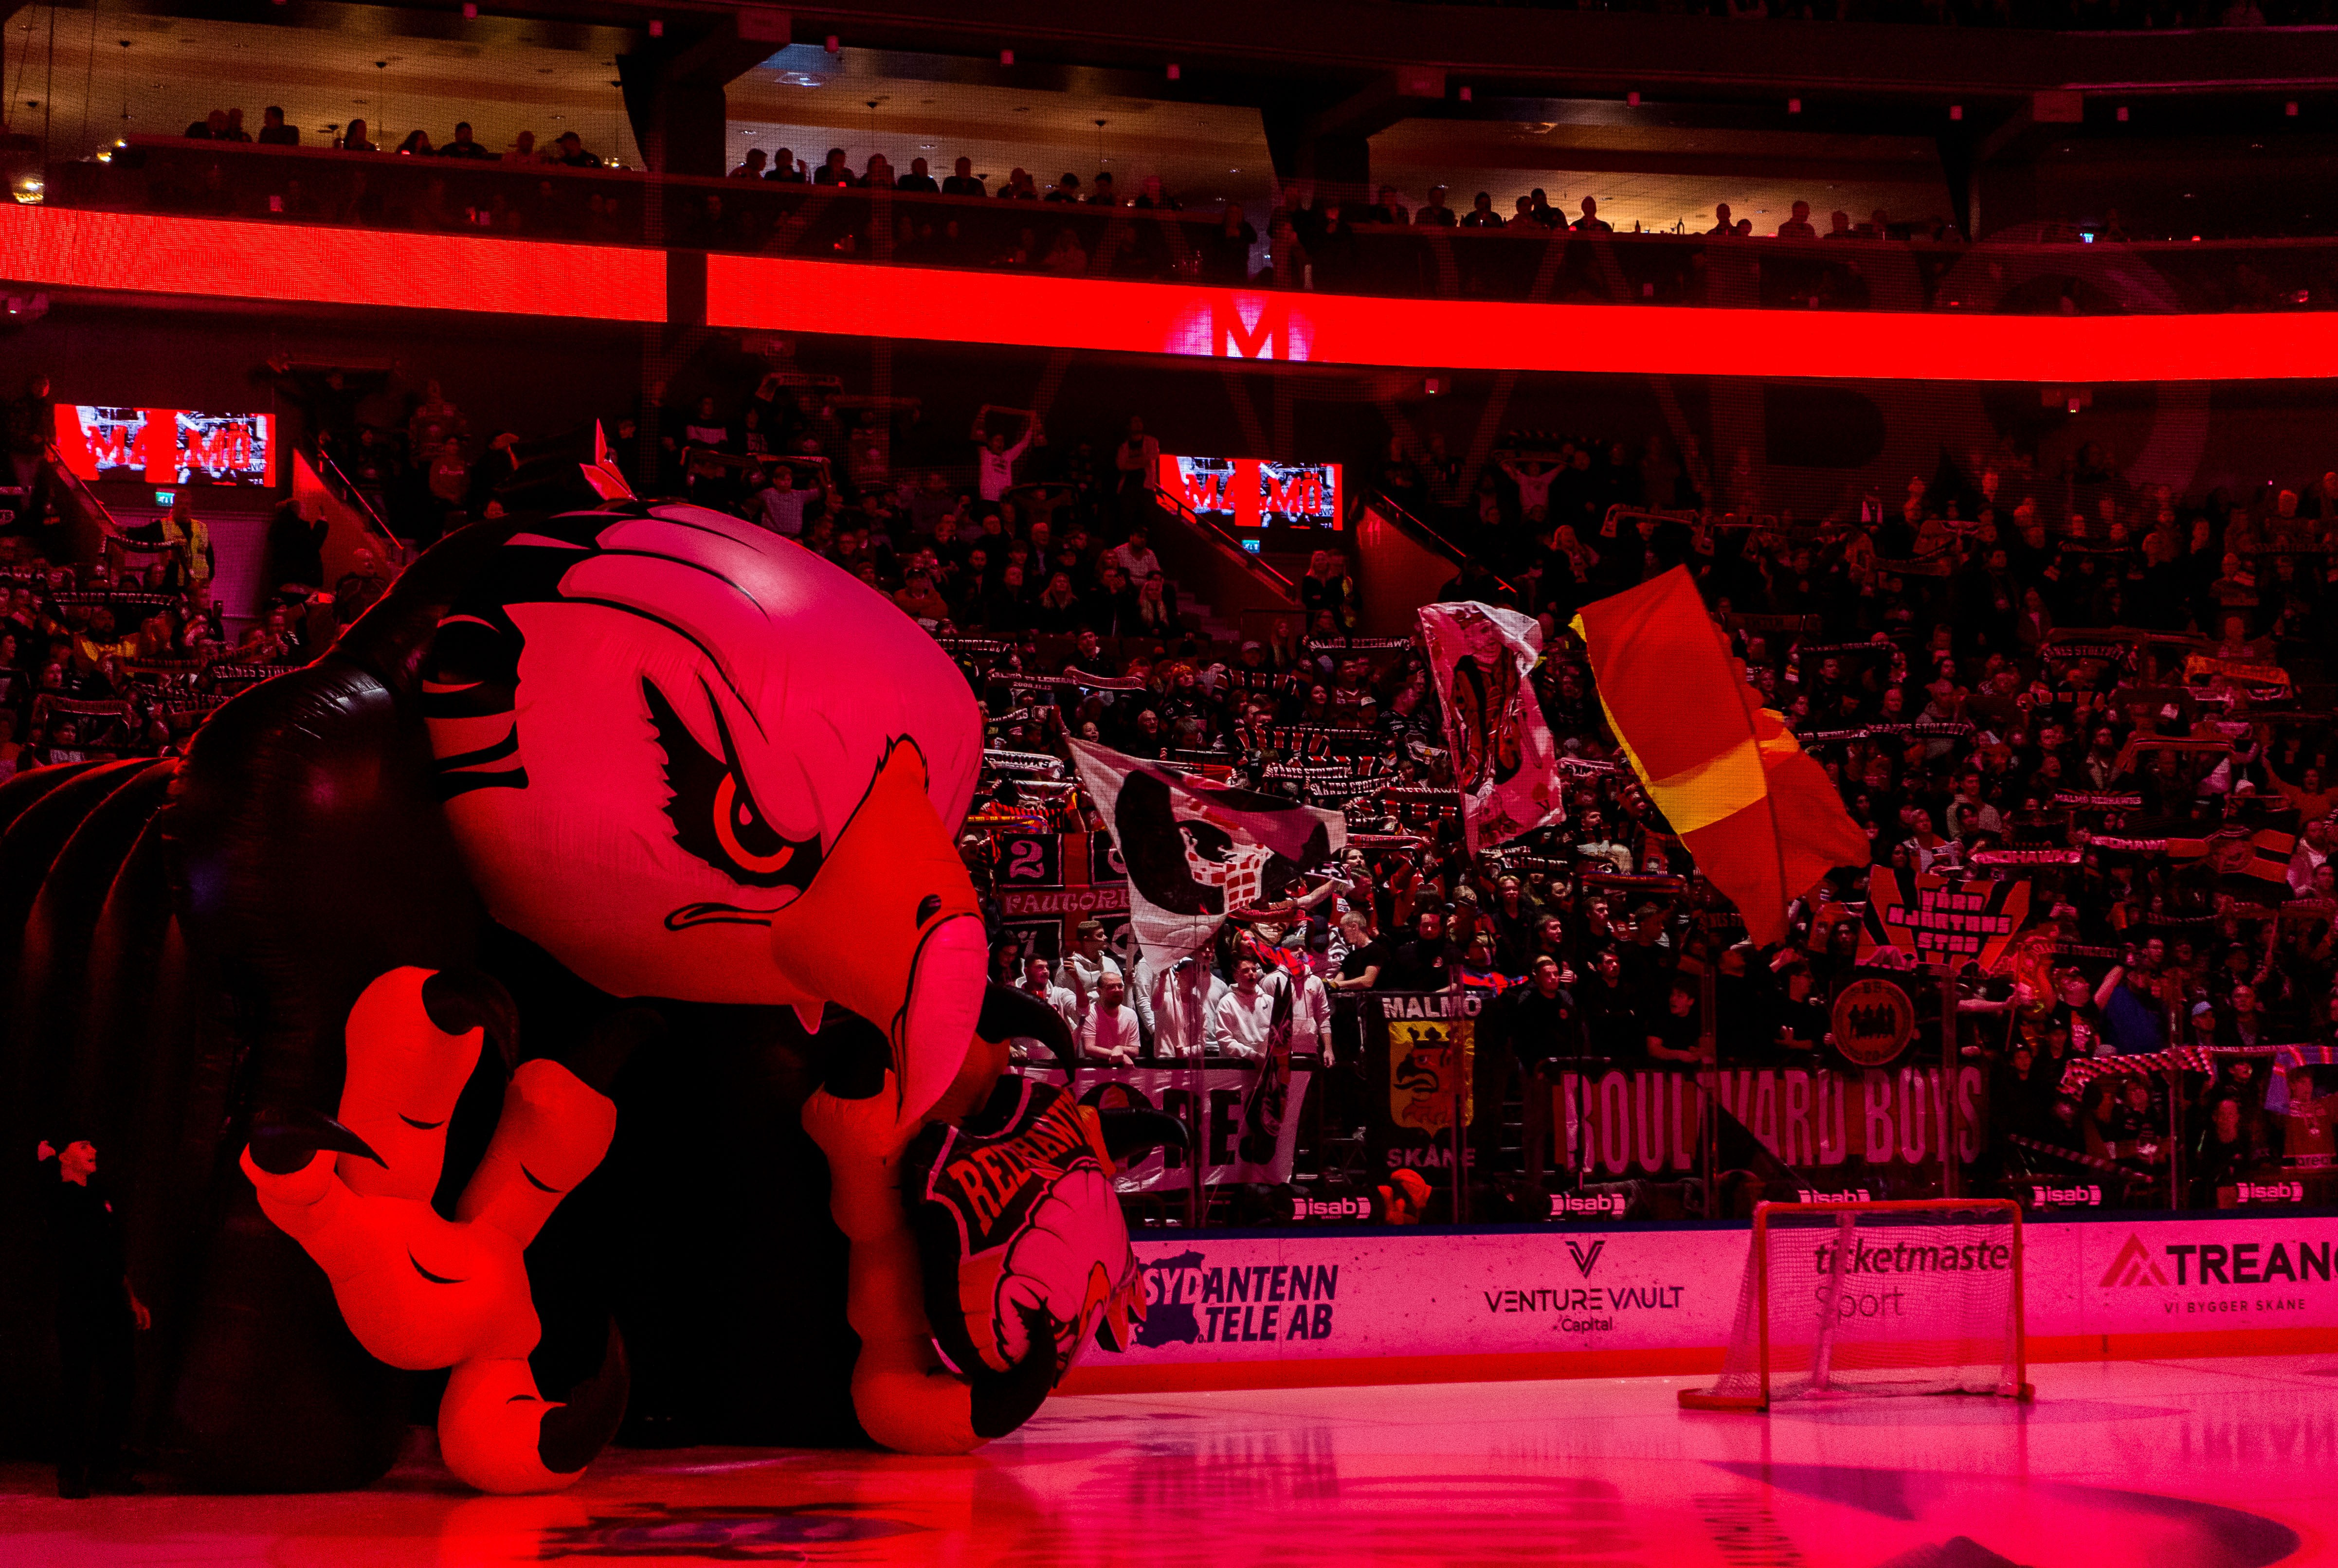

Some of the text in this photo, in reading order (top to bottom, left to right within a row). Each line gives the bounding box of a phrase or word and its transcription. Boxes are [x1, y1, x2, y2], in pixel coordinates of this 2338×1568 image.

[88, 422, 251, 469] MAMÖ
[1185, 472, 1321, 514] MAMÖ
[1010, 840, 1045, 879] 2
[1382, 991, 1483, 1019] MALMÖ
[1865, 1065, 1983, 1165] BOYS
[1387, 1143, 1476, 1168] SKÅNE
[1565, 1193, 1612, 1211] isab
[2046, 1184, 2089, 1202] isab
[2250, 1181, 2290, 1198] isab
[1309, 1197, 1357, 1215] isab
[2166, 1242, 2338, 1286] TREAN
[1142, 1265, 1339, 1306] SYDANTENN
[1484, 1286, 1685, 1313] VENTURE VAULT
[2165, 1296, 2306, 1314] VI BYGGER SKÅNE
[1287, 1303, 1334, 1340] AB
[1561, 1316, 1613, 1334] Capital
